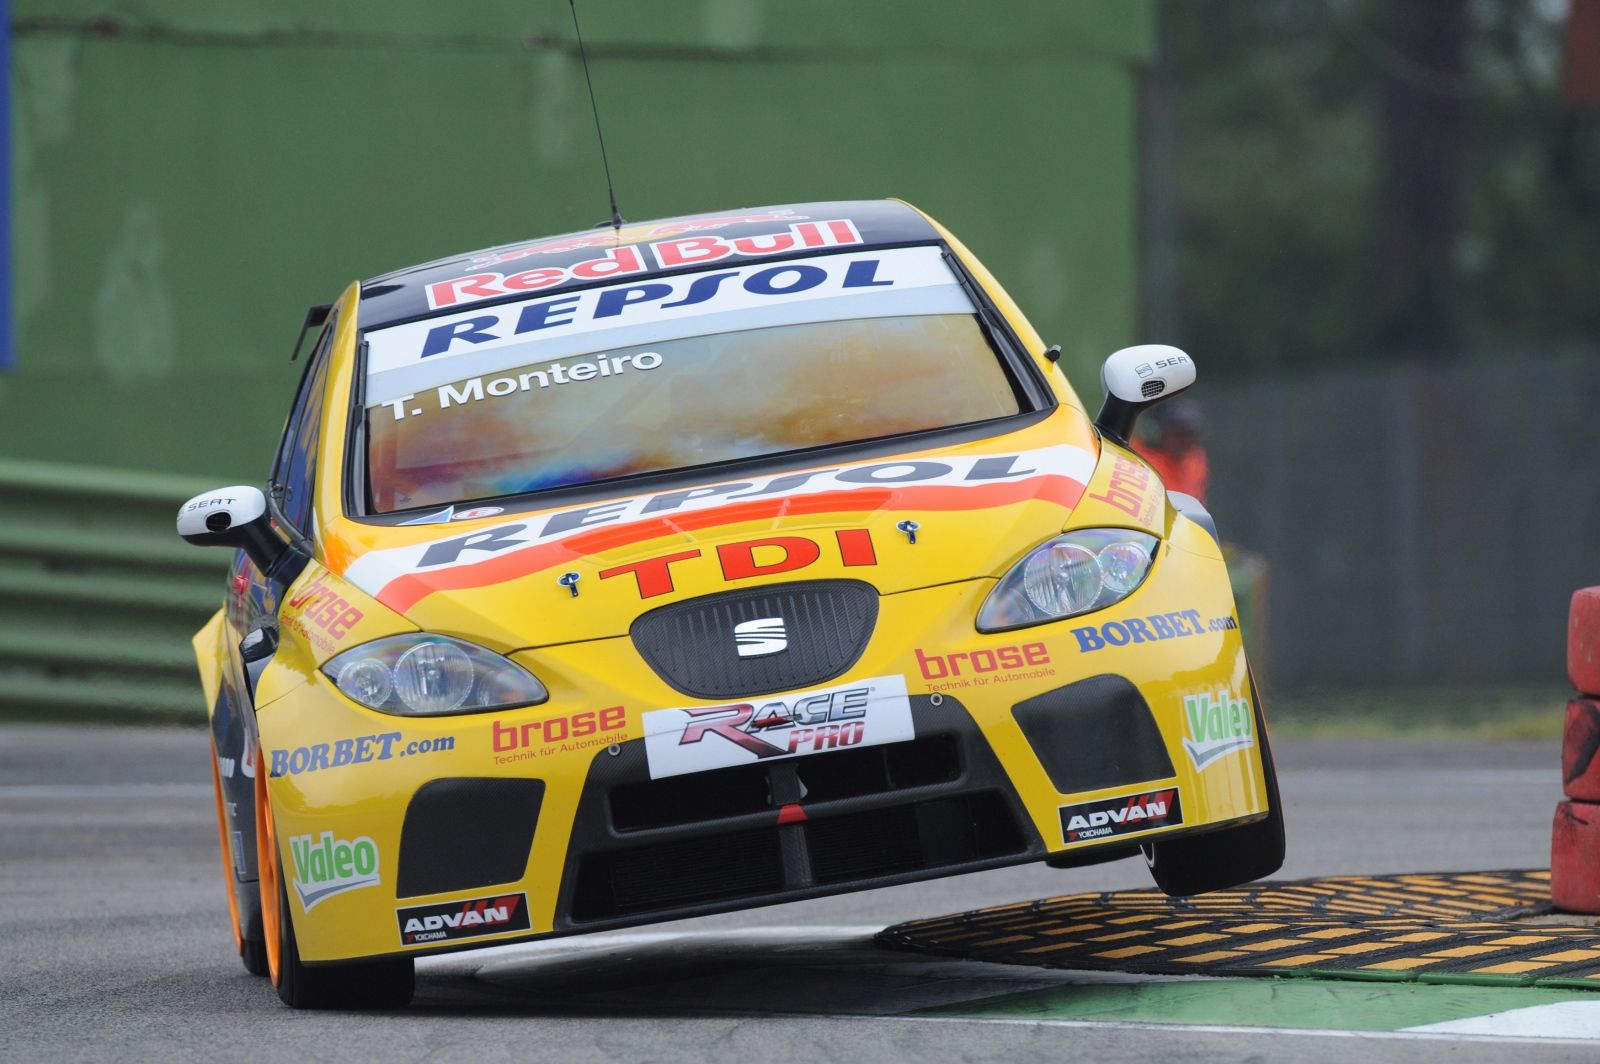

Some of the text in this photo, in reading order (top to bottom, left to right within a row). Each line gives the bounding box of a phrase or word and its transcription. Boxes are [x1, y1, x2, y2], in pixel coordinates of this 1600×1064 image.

[427, 219, 860, 308] Red Bull
[420, 260, 895, 358] REPSOL
[1155, 356, 1188, 369] SEA
[382, 352, 663, 420] T. Monteiro
[187, 498, 237, 512] SEAT
[1088, 455, 1151, 518] bros
[416, 456, 1037, 567] REPSOL
[599, 528, 878, 600] TDI
[1070, 609, 1238, 653] BORBET.com
[914, 642, 1050, 680] brose
[926, 668, 1056, 692] Technik für Automobile
[493, 706, 626, 752] brose
[679, 688, 869, 760] RACE
[787, 721, 866, 755] PRO
[1186, 694, 1251, 743] Valeo
[270, 731, 455, 778] BORBET.com
[494, 732, 628, 765] Technik für Automobile
[1067, 801, 1167, 831] ADVAN
[292, 836, 376, 885] Valeo
[404, 906, 509, 933] ADVAN
